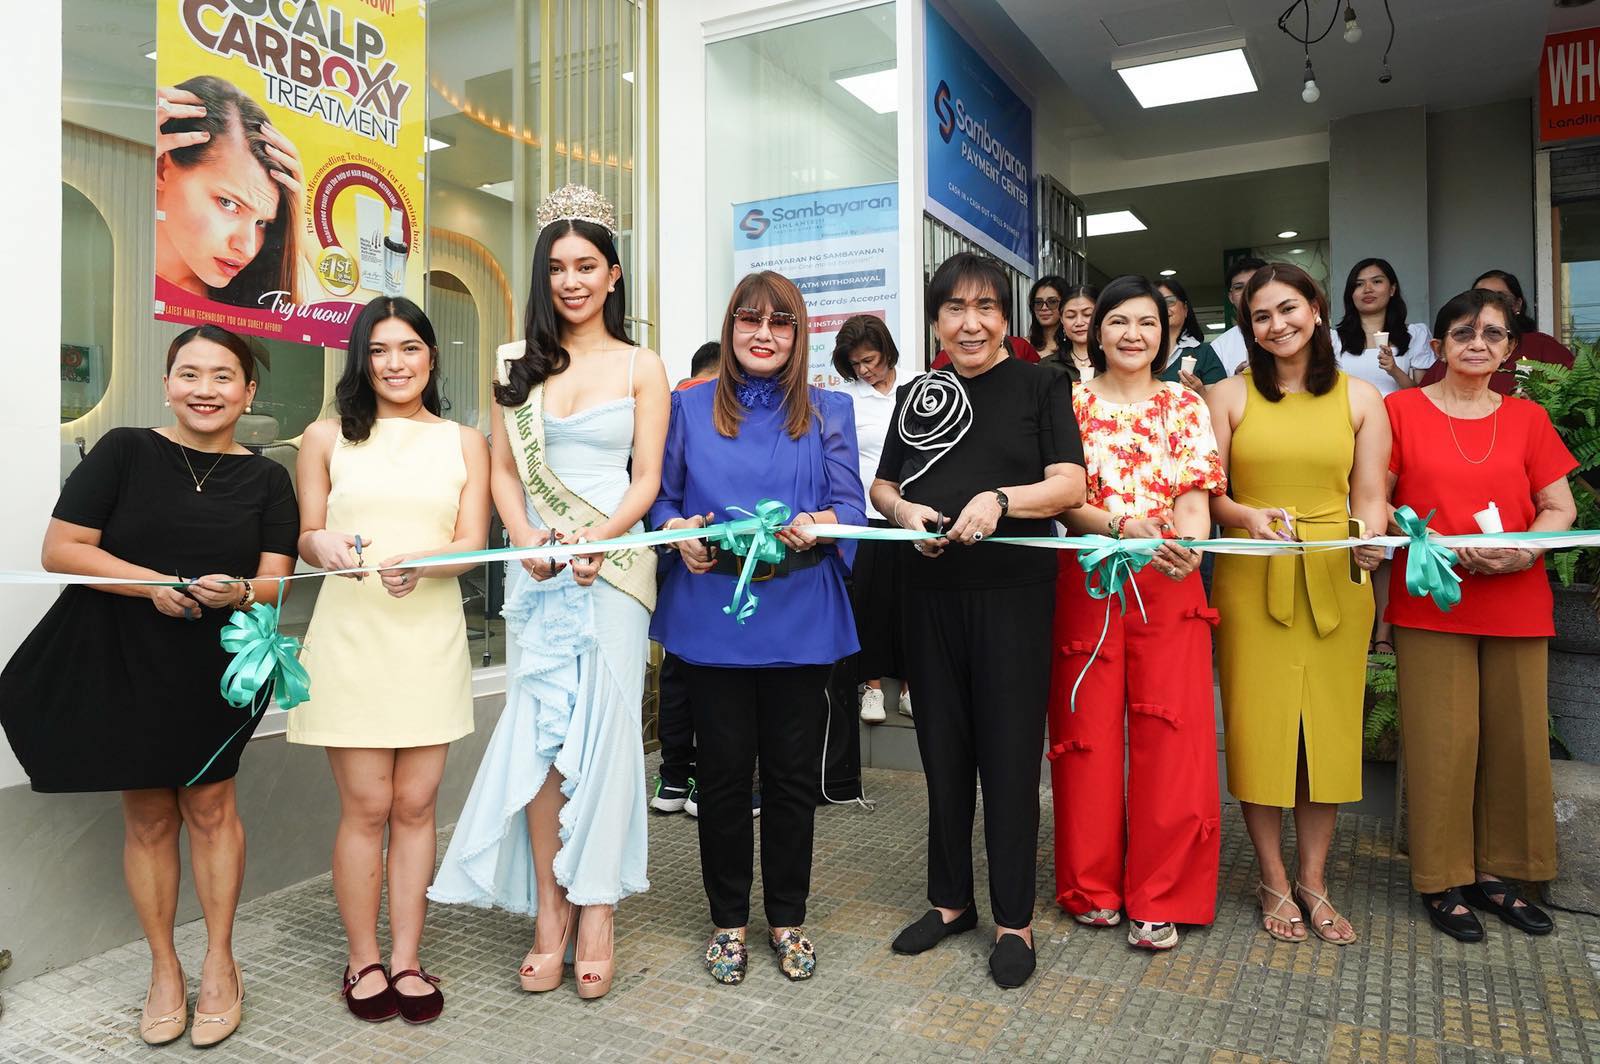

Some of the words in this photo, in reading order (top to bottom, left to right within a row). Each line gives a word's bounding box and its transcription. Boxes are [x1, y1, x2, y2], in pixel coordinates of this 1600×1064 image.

[183, 0, 409, 120] CARBOXY
[1547, 39, 1600, 107] WH
[263, 72, 399, 145] TREATMENT
[955, 98, 1027, 186] Sambayaran
[307, 154, 346, 193] Microneedling
[346, 152, 386, 173] Technology
[387, 170, 398, 184] for
[961, 141, 999, 185] PAYMENT
[1001, 175, 1028, 208] CENTER
[305, 195, 313, 215] First
[398, 183, 418, 228] thinning
[772, 196, 892, 222] Sambayaran
[947, 182, 960, 198] CASH
[969, 197, 981, 212] CASH
[306, 217, 314, 236] The
[750, 256, 807, 269] SAMBAYARAN
[809, 254, 822, 262] NG
[823, 247, 885, 260] SAMBAYANAN
[801, 281, 819, 289] ATM
[821, 275, 881, 287] WITHDRAWAL
[258, 290, 296, 321] Try
[297, 303, 312, 318] it
[312, 303, 355, 325] now!
[820, 297, 847, 306] Cards
[850, 292, 897, 303] Accepted
[165, 304, 182, 316] LATEST
[183, 307, 196, 319] HAIR
[196, 310, 226, 323] TECHNOLOGY
[227, 315, 236, 325] YOU
[237, 317, 247, 327] CAN
[515, 403, 533, 440] Miss
[524, 438, 571, 517] Philippines
